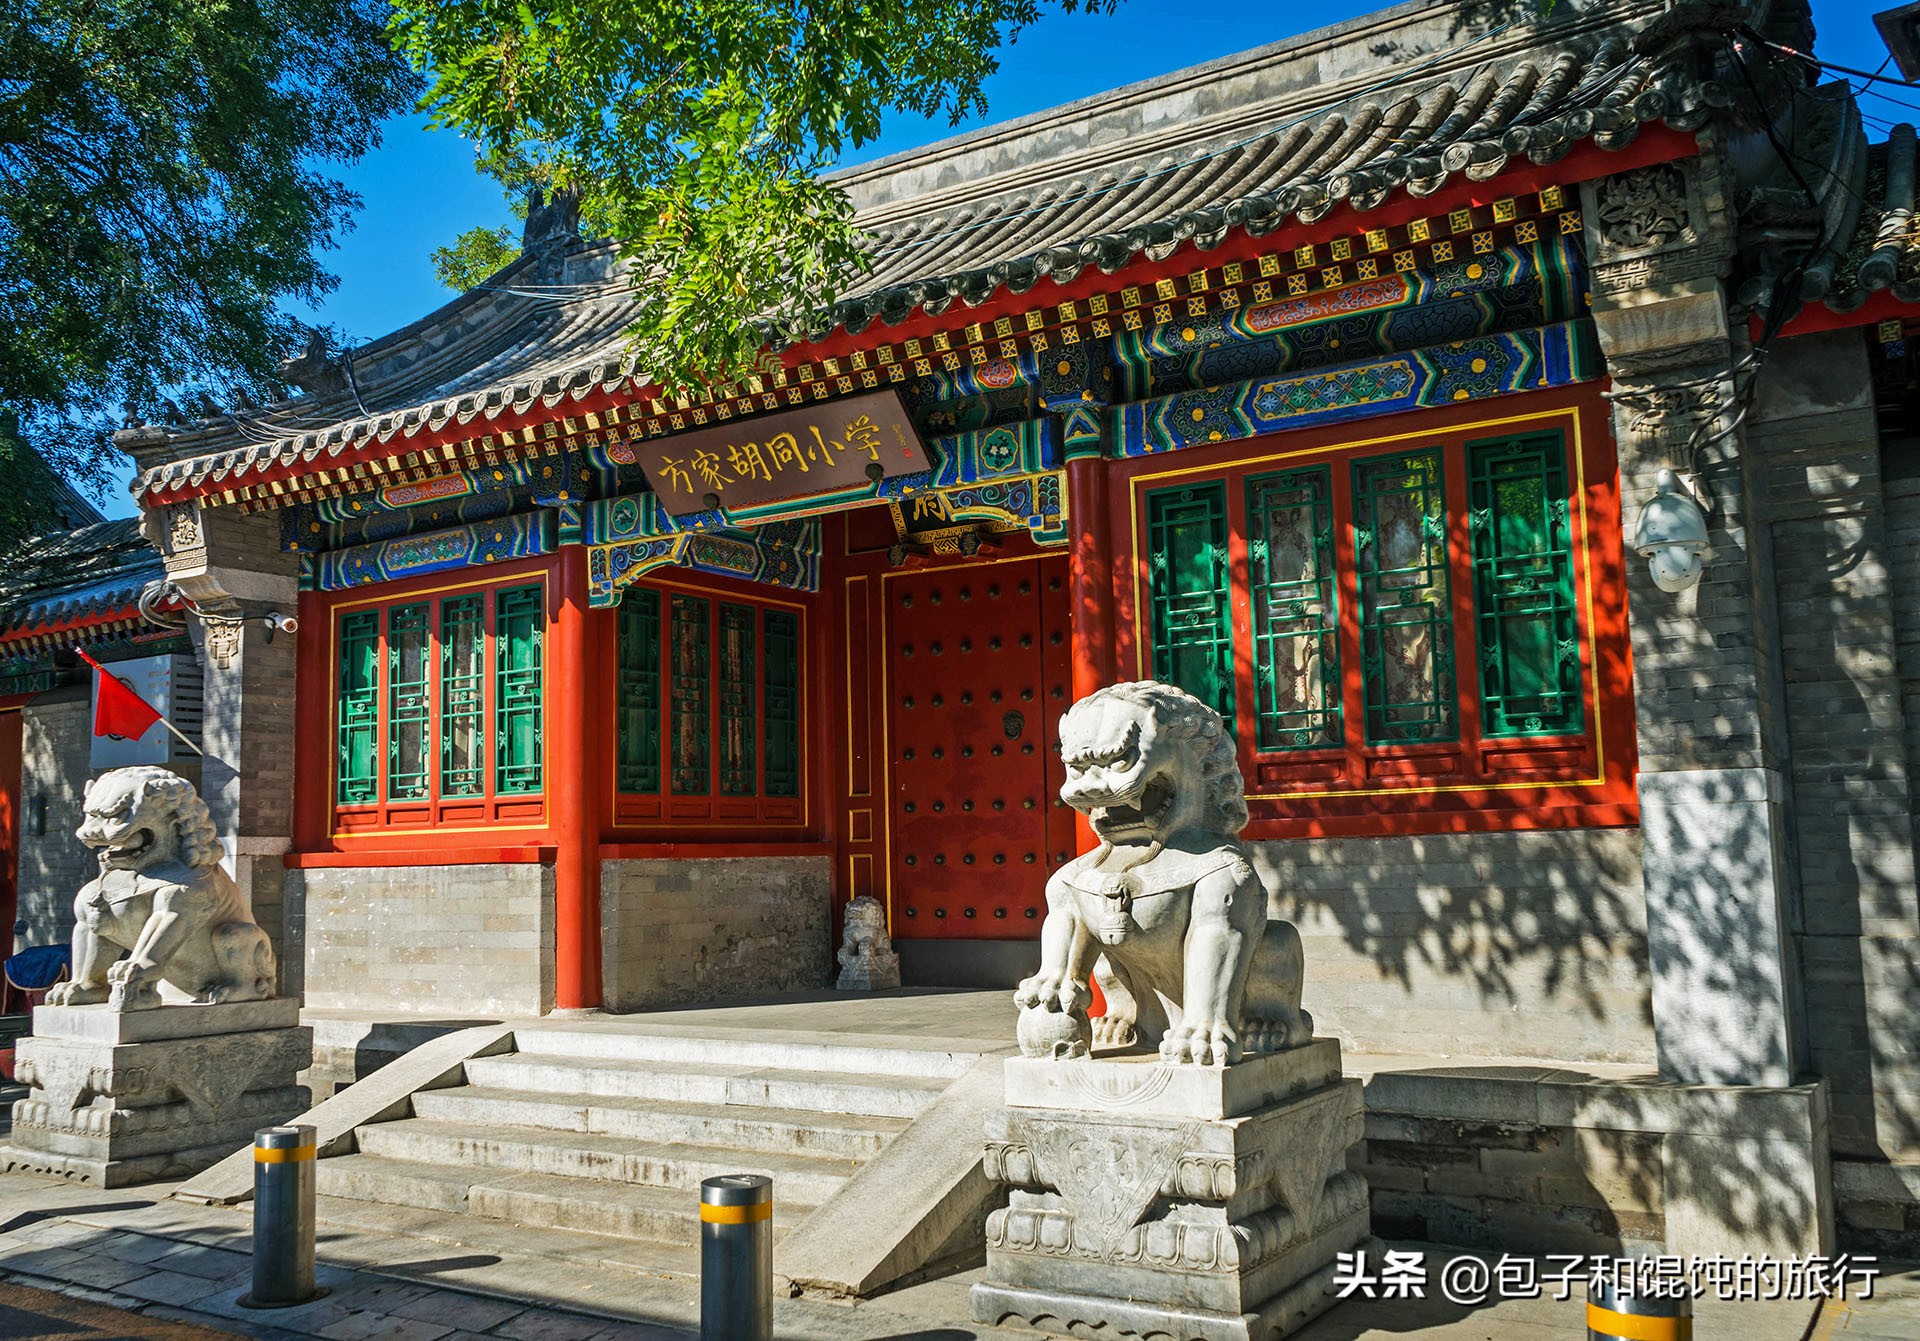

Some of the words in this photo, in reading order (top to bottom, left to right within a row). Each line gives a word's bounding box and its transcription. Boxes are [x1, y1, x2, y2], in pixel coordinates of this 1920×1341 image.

[658, 415, 881, 494] 方家胡同小学
